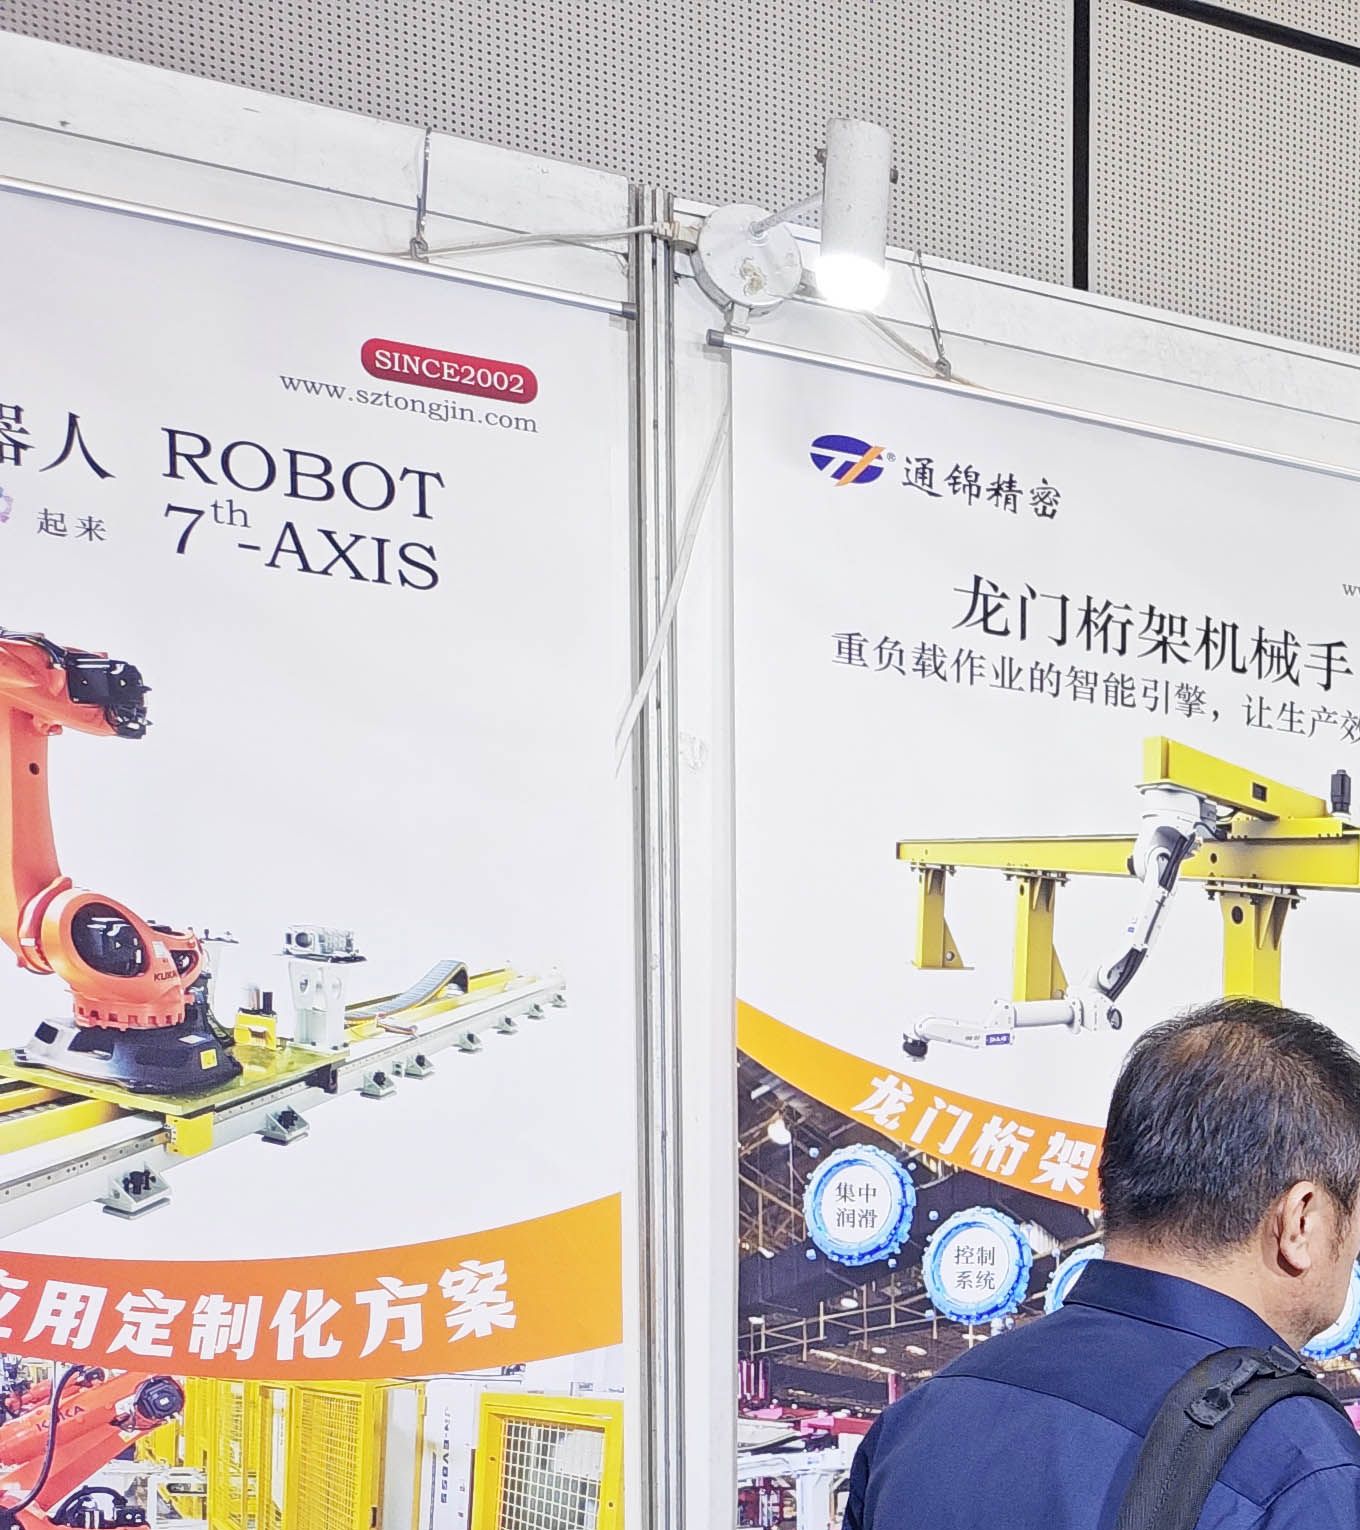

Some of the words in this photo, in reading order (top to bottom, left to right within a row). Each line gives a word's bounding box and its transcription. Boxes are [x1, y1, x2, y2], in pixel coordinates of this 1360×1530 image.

[374, 348, 525, 396] SINCE2002
[280, 374, 539, 434] www.sztongjin.com
[161, 427, 445, 520] ROBOT
[902, 456, 1061, 519] 通锦精密
[37, 508, 107, 541] 起来
[952, 574, 1354, 693] 龙门桁架机械手
[852, 1074, 1096, 1195] 龙门桁架
[836, 1182, 877, 1204] 集中
[836, 1207, 878, 1229] 润滑
[954, 1245, 995, 1267] 控制
[955, 1270, 996, 1291] 系统
